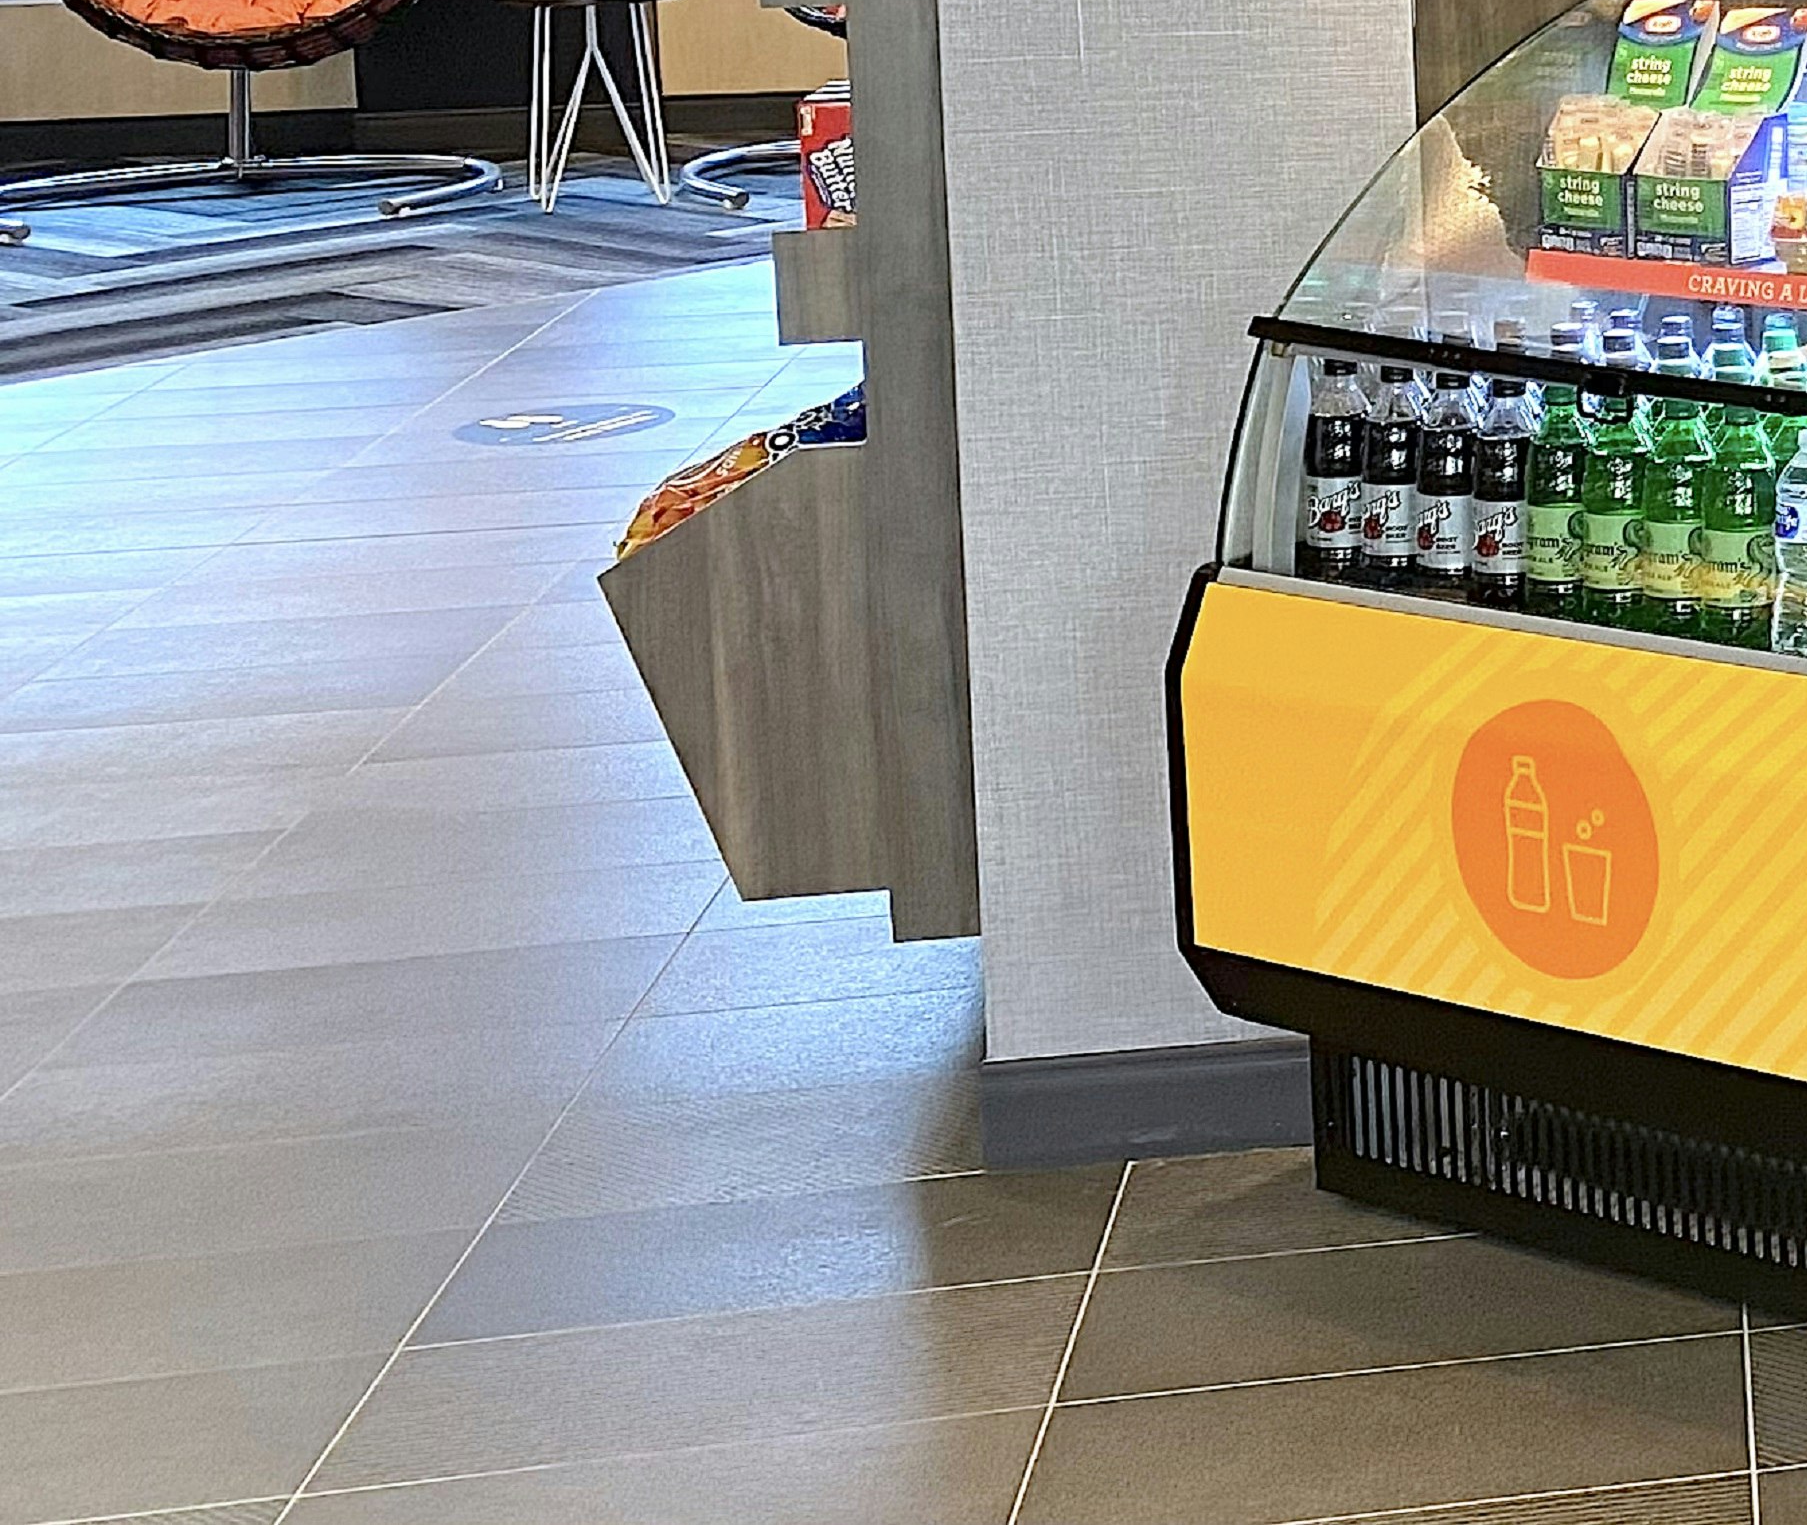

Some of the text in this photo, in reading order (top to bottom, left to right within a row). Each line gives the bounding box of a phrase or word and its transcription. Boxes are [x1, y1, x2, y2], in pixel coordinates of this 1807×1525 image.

[1631, 55, 1672, 74] string
[1626, 70, 1672, 85] cheese
[1729, 65, 1772, 83] string
[1721, 79, 1772, 92] cheese
[1559, 176, 1600, 194] string
[1655, 182, 1701, 200] string
[1556, 189, 1604, 207] cheese
[1653, 196, 1704, 213] cheese
[1688, 274, 1775, 301] CRAVING
[1779, 282, 1794, 302] A
[1308, 481, 1362, 530] Barq's
